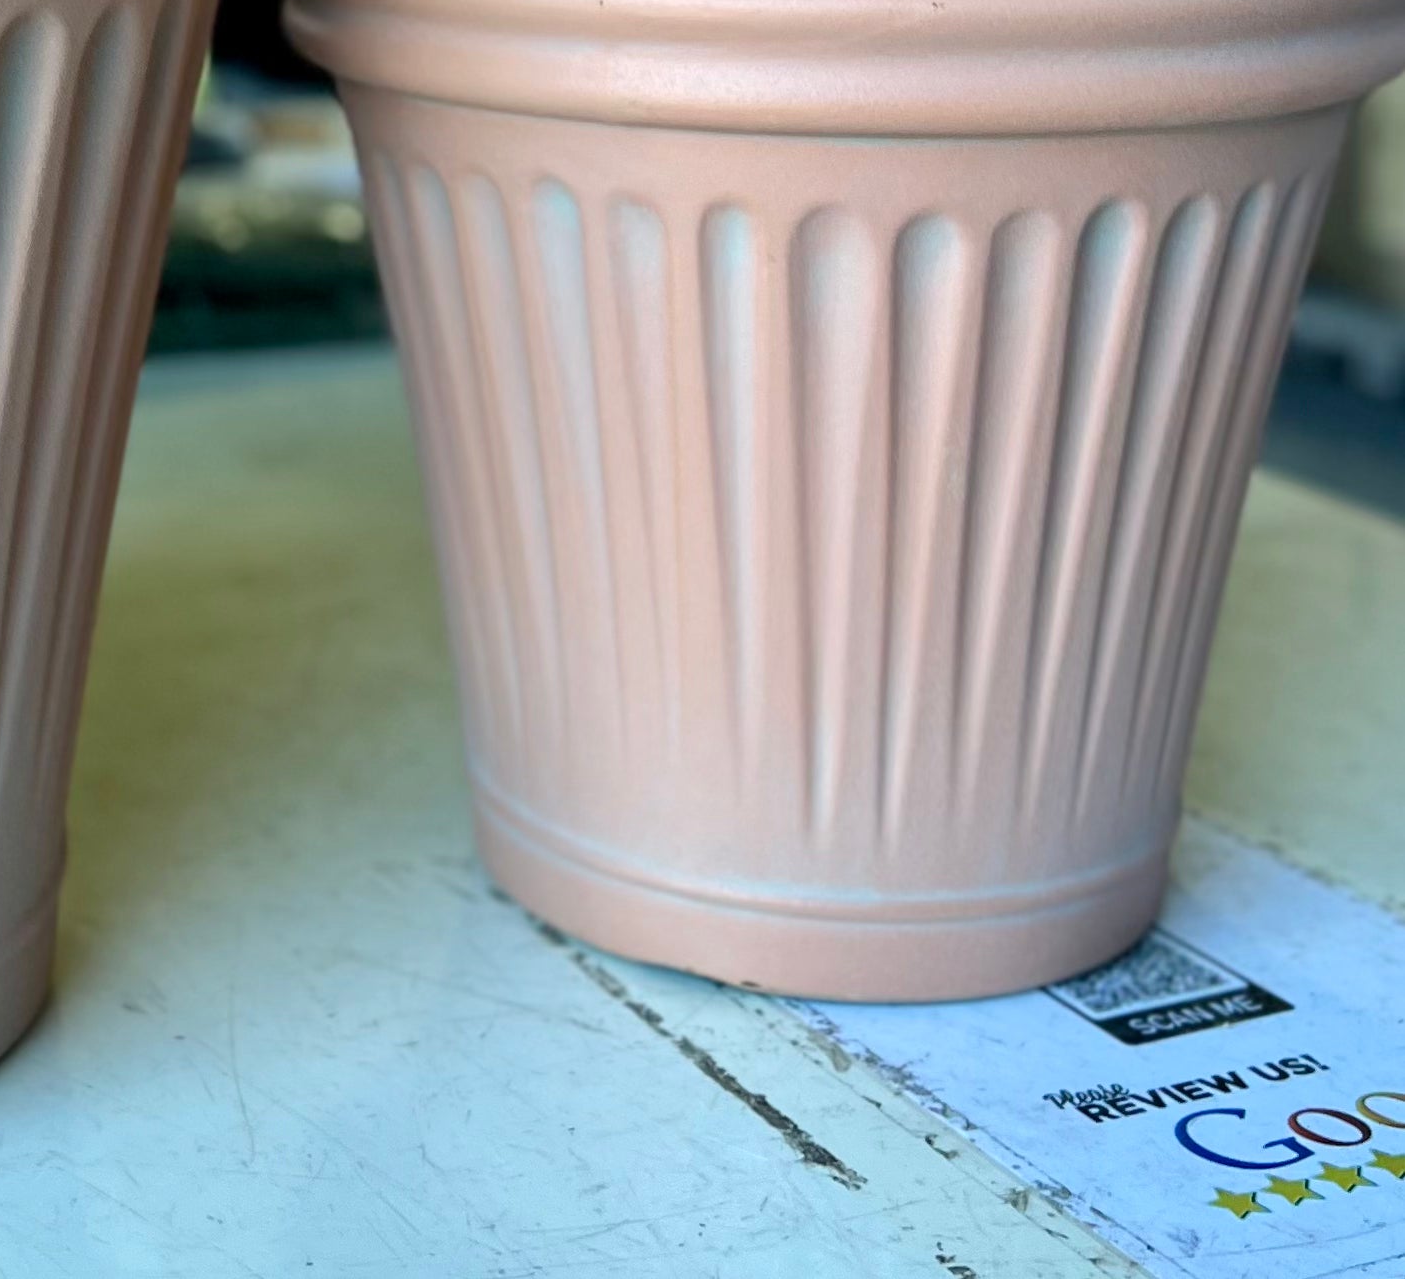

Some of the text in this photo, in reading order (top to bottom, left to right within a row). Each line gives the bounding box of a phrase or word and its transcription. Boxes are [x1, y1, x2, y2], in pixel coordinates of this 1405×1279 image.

[1128, 993, 1263, 1035] SCAN ME
[1076, 1054, 1331, 1123] REVIEW US!
